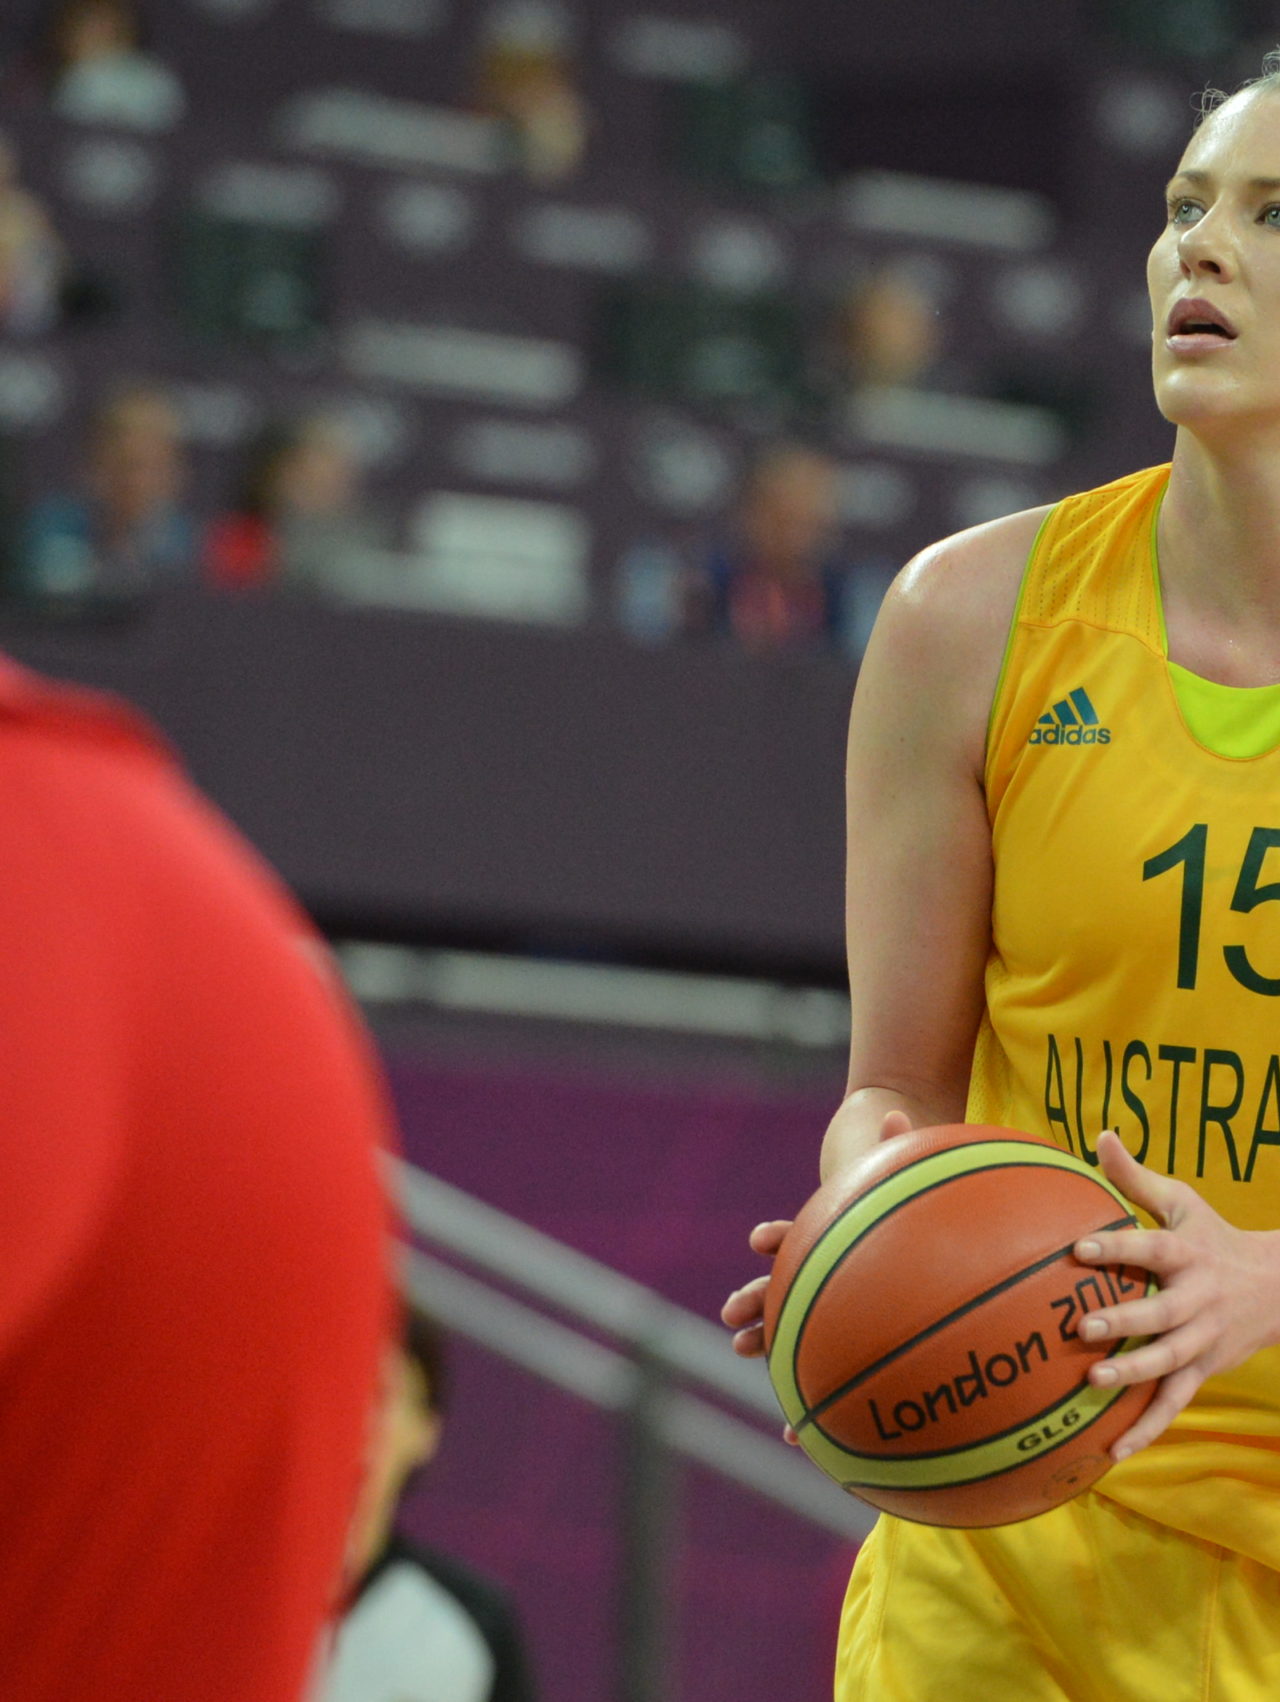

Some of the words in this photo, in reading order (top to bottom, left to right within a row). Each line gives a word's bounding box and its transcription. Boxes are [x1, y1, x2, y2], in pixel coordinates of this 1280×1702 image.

[1028, 723, 1111, 745] adidas
[868, 1330, 1049, 1441] London
[1017, 1407, 1080, 1451] GL6
